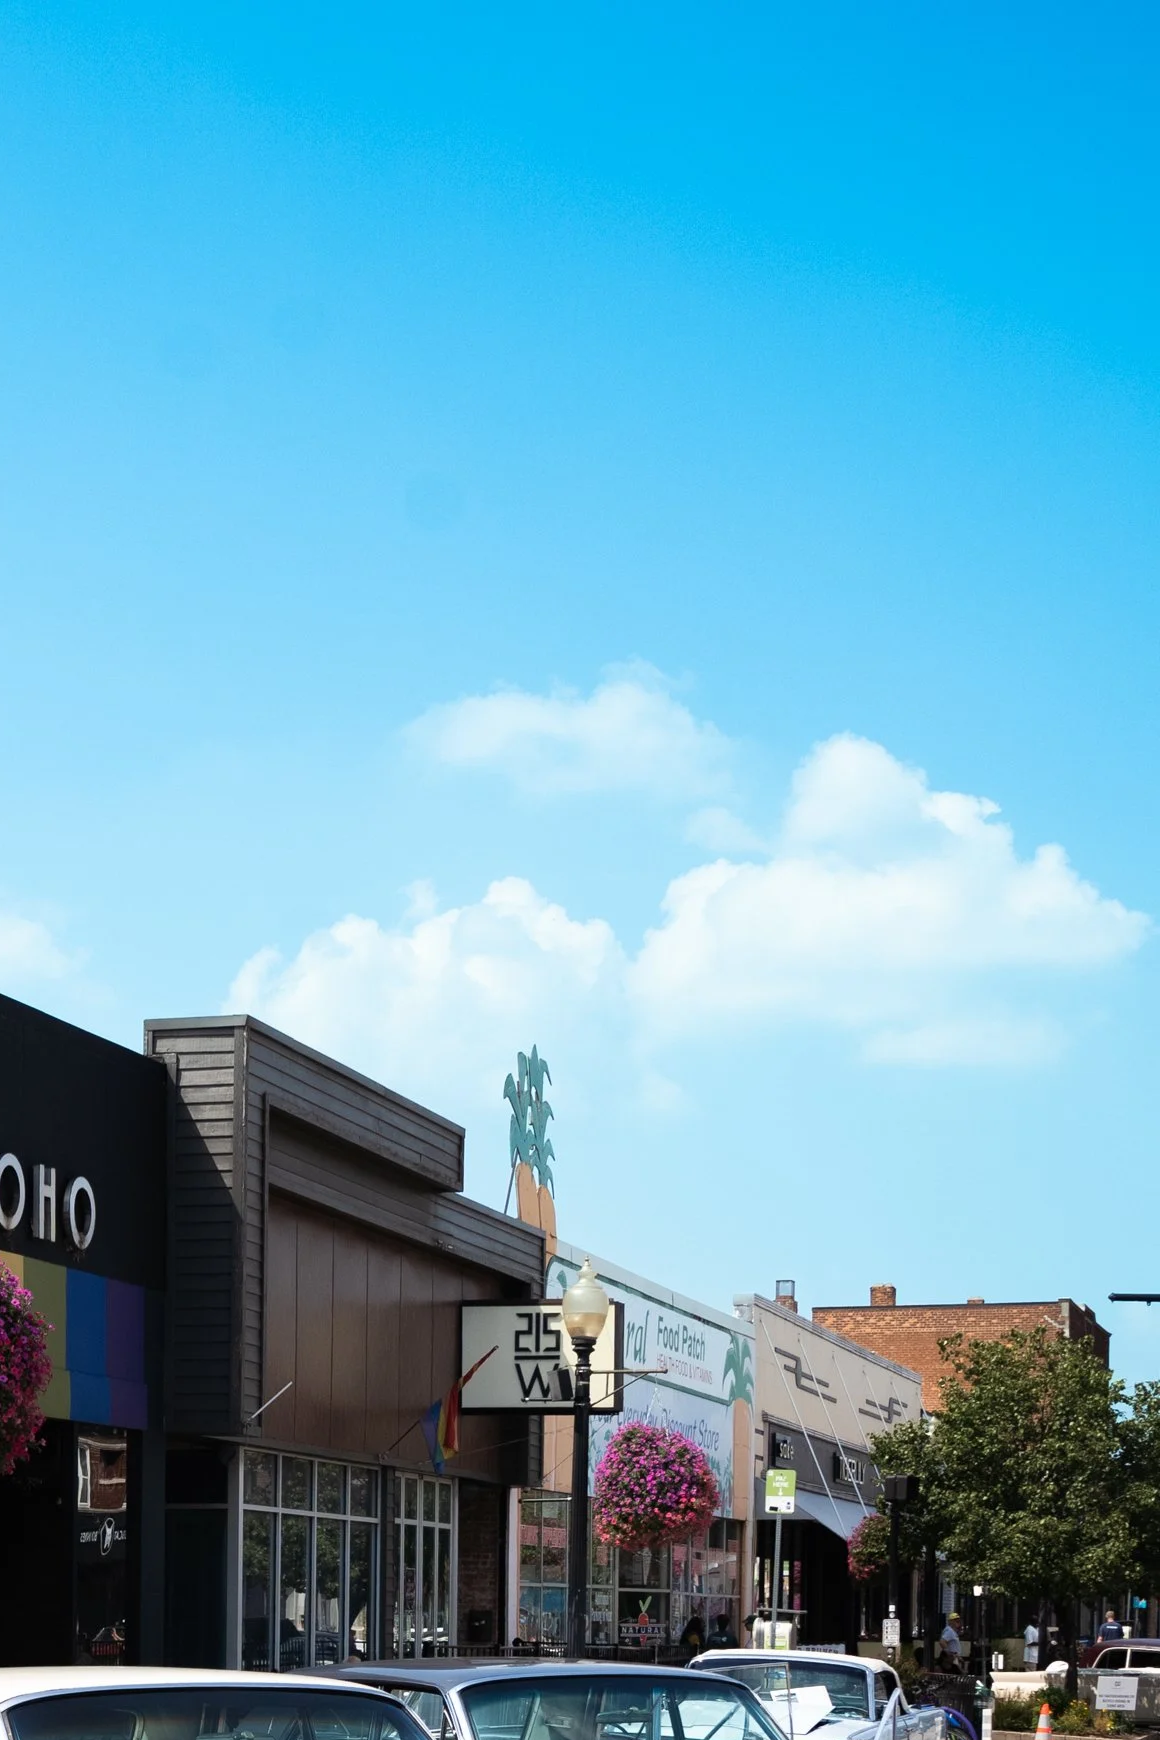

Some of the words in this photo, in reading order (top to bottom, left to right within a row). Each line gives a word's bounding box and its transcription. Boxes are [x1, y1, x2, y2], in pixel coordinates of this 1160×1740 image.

[656, 1315, 680, 1353] Food
[681, 1325, 705, 1361] Patch
[698, 1419, 719, 1451] Store
[621, 1626, 665, 1634] NATURAL
